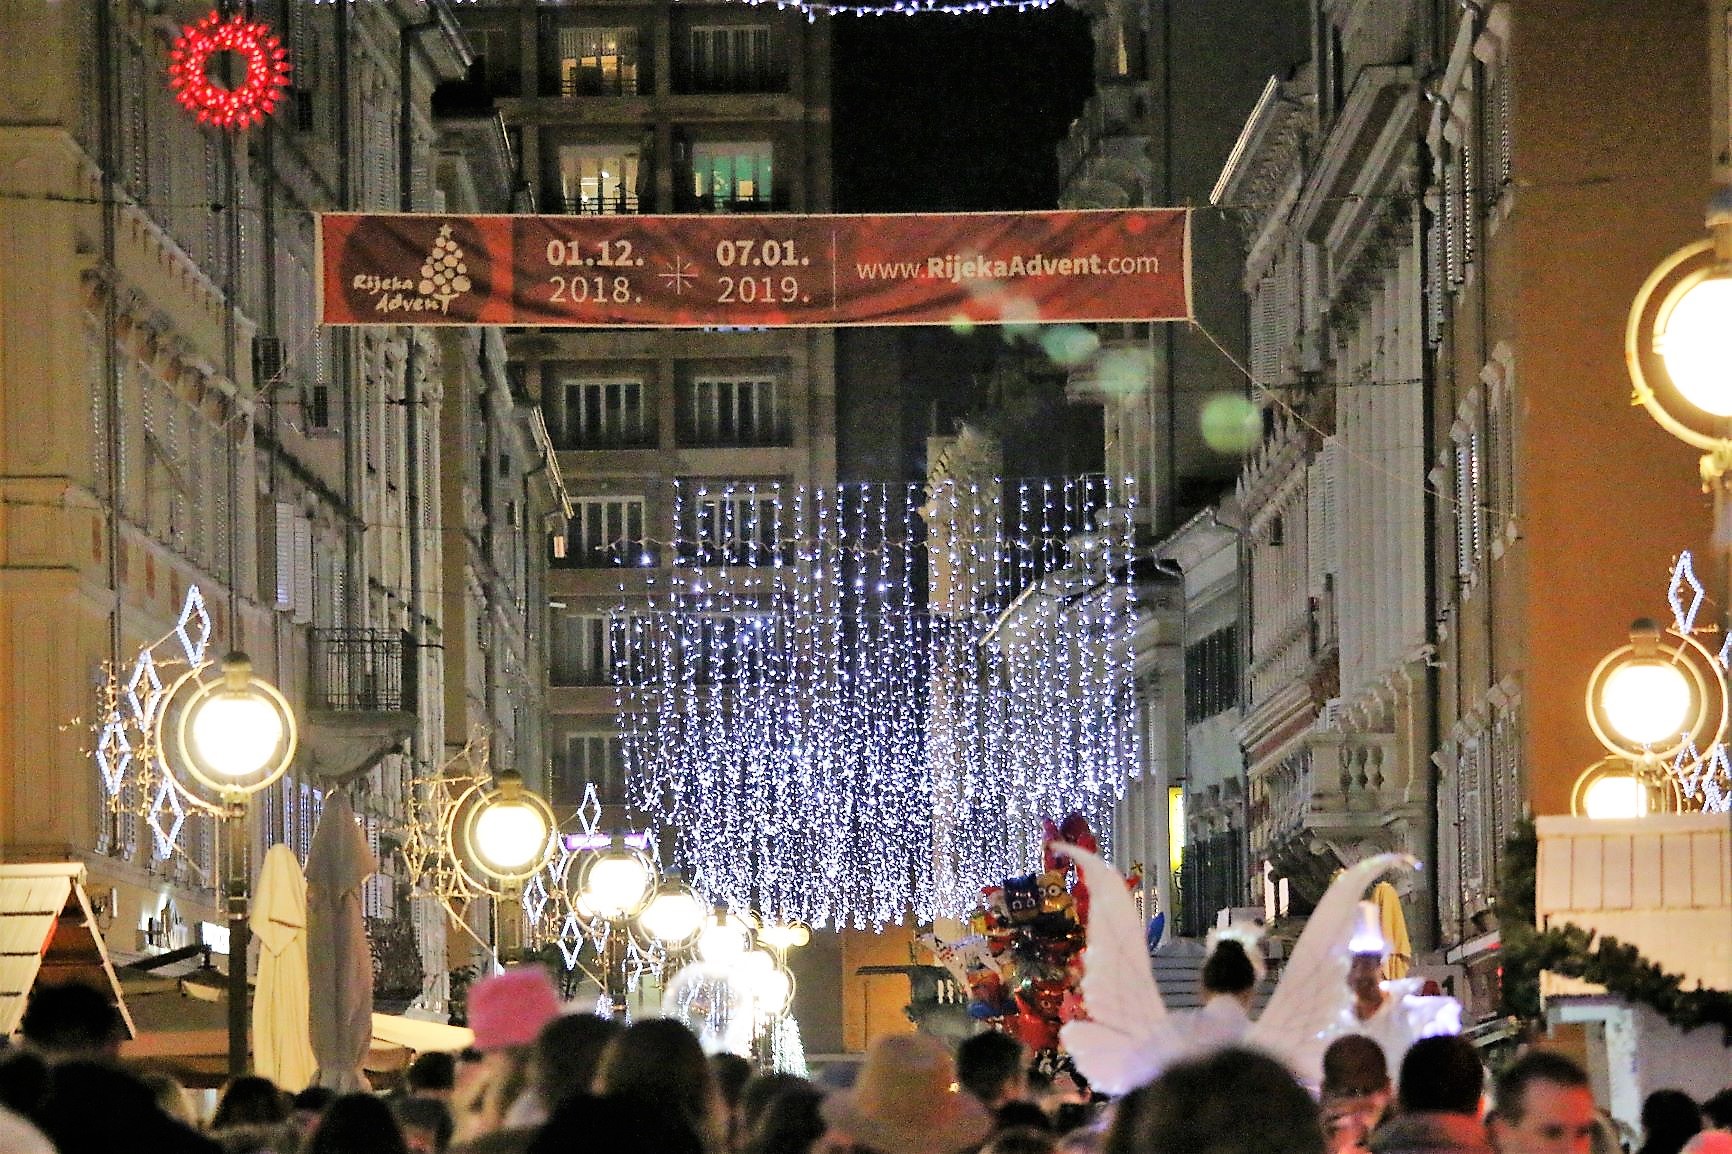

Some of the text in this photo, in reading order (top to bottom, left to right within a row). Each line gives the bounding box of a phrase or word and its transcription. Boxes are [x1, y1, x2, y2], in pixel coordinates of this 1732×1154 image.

[546, 239, 644, 266] 01.12.
[716, 239, 810, 266] 07.01.
[856, 254, 1159, 282] www.RijekaAdvent.com
[354, 274, 413, 294] Rijeka
[549, 276, 642, 303] 2018.
[717, 276, 810, 303] 2019.
